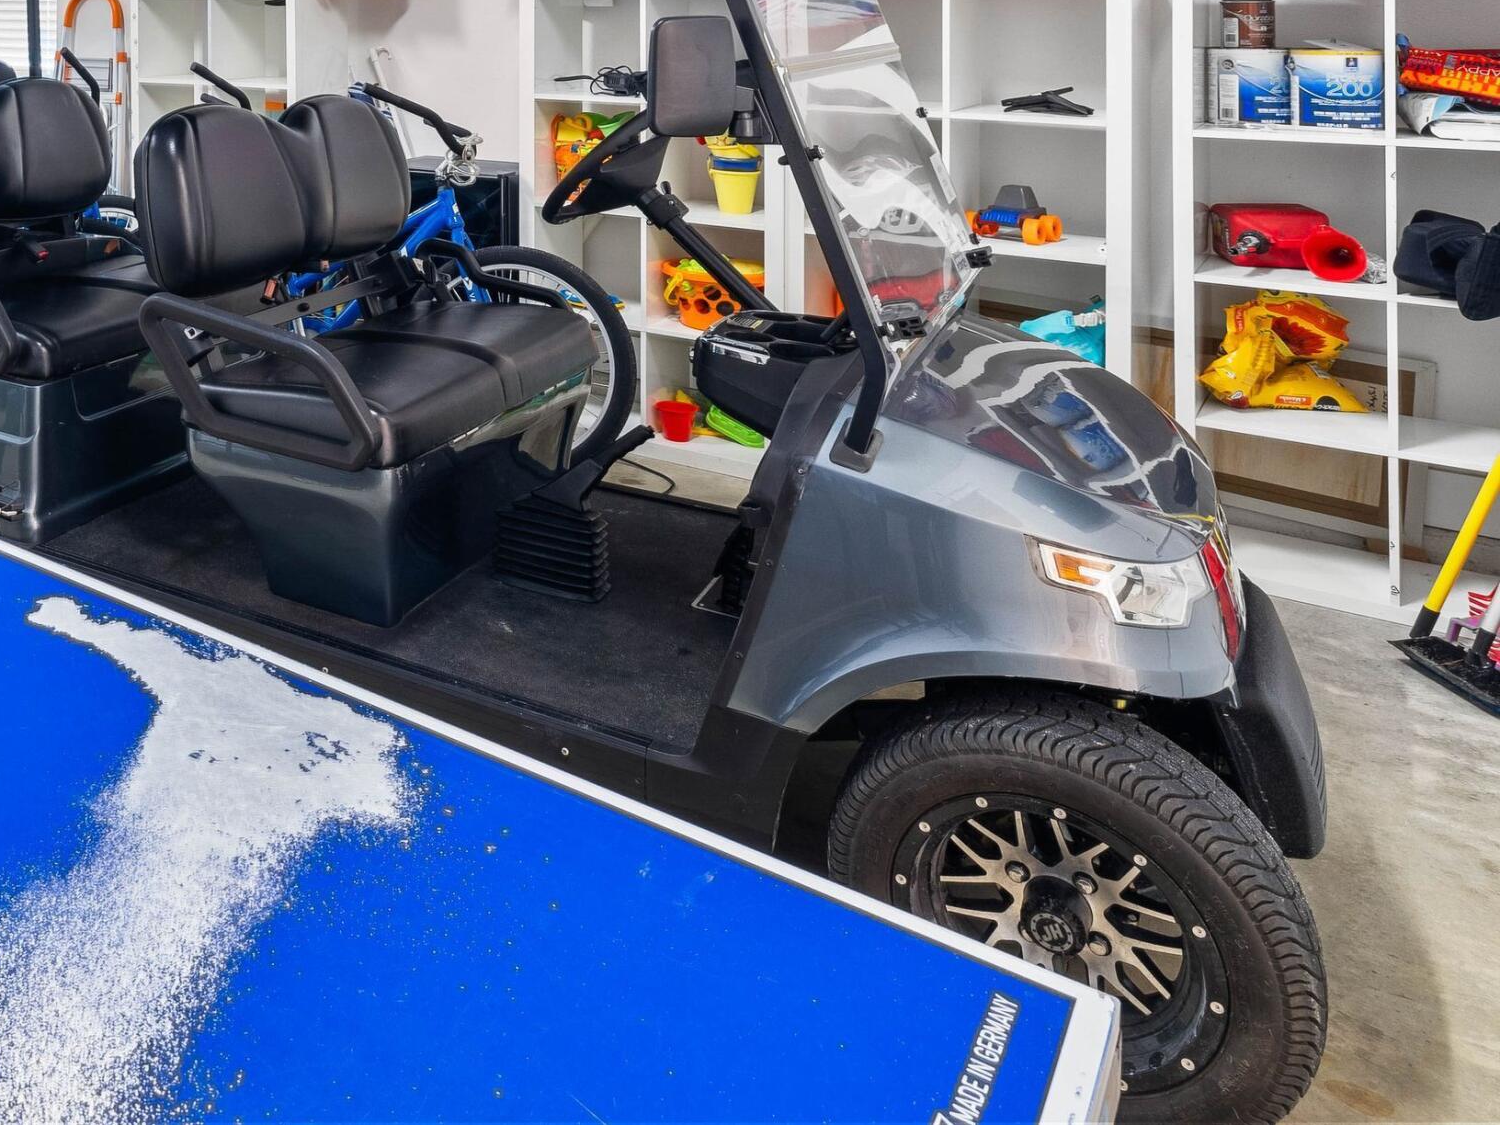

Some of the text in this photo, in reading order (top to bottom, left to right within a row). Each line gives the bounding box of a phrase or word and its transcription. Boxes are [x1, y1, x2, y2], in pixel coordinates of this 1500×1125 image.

[1326, 81, 1373, 97] 200
[1041, 923, 1064, 942] JH
[949, 992, 1019, 1125] MADE IN GERMANY
